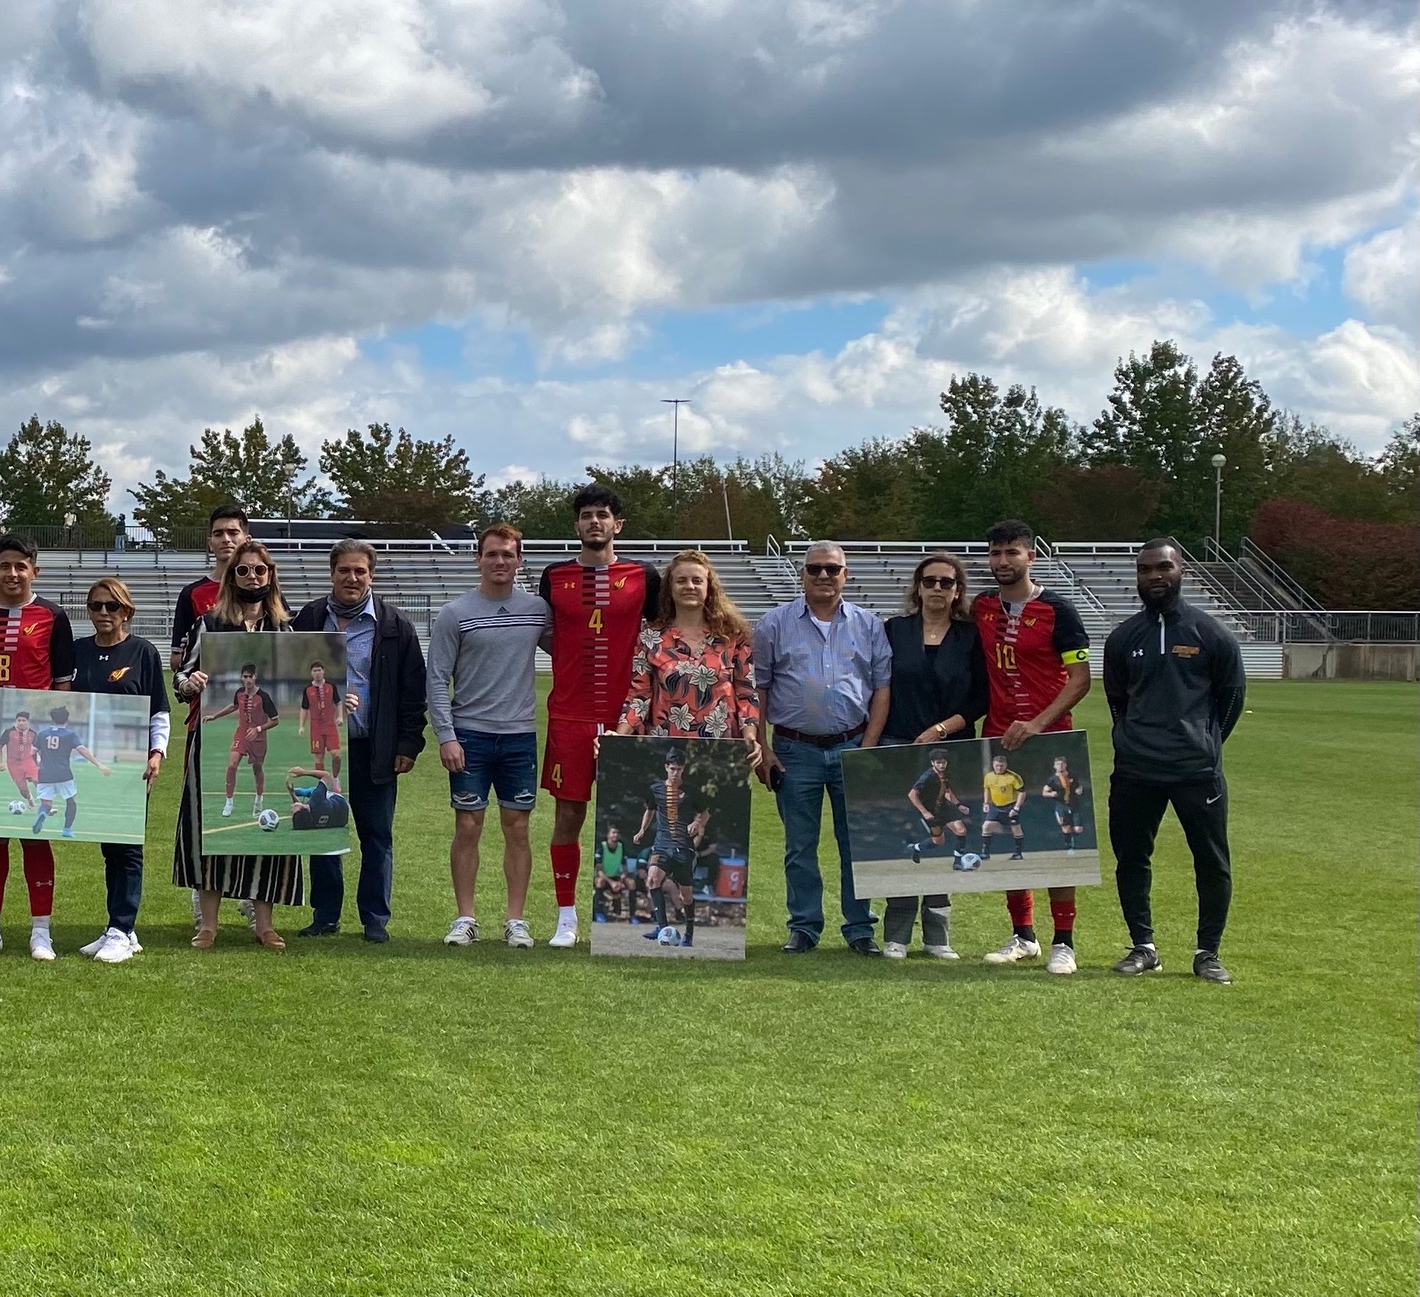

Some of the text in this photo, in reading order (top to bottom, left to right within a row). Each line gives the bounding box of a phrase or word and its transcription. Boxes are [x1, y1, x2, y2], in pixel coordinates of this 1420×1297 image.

[588, 608, 603, 635] 4
[995, 642, 1017, 670] 10
[1076, 650, 1087, 661] C
[45, 735, 60, 750] 19
[551, 763, 563, 789] 4
